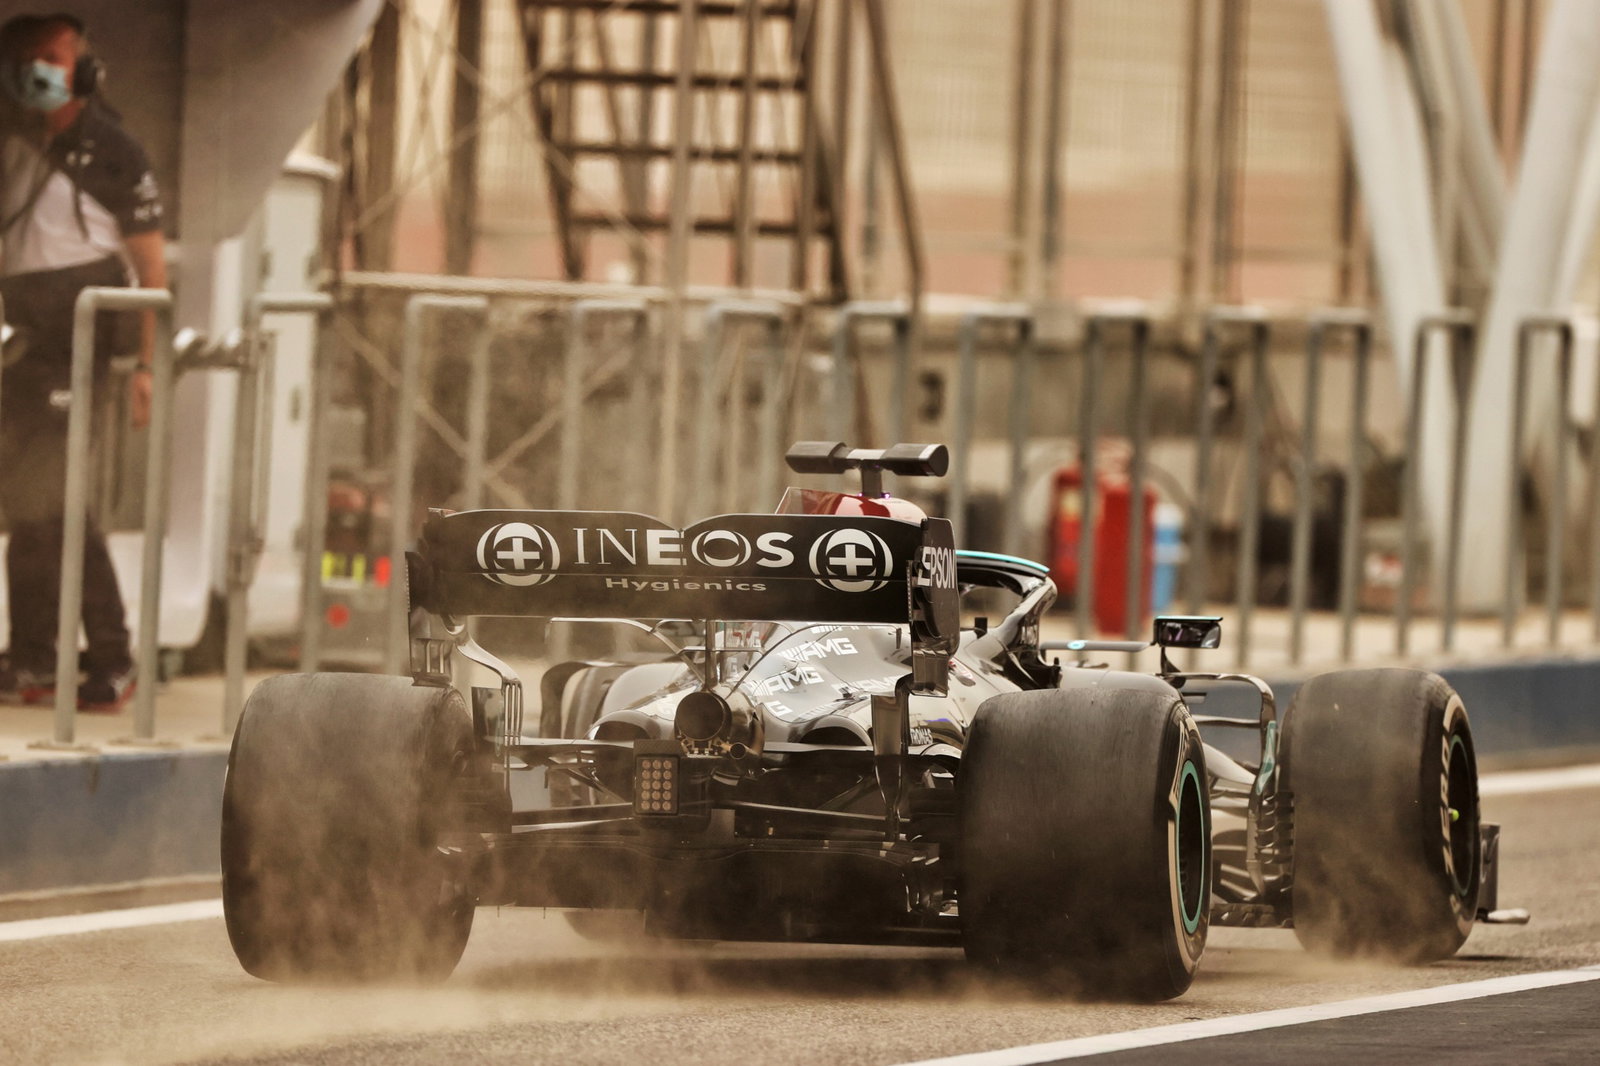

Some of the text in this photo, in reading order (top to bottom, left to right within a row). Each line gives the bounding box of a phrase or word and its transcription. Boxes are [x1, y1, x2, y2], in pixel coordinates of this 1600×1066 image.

[572, 527, 795, 568] INEOS
[917, 546, 955, 589] EPSON
[605, 577, 767, 592] Hygienics
[795, 637, 859, 662] AMG
[760, 666, 825, 696] AMG
